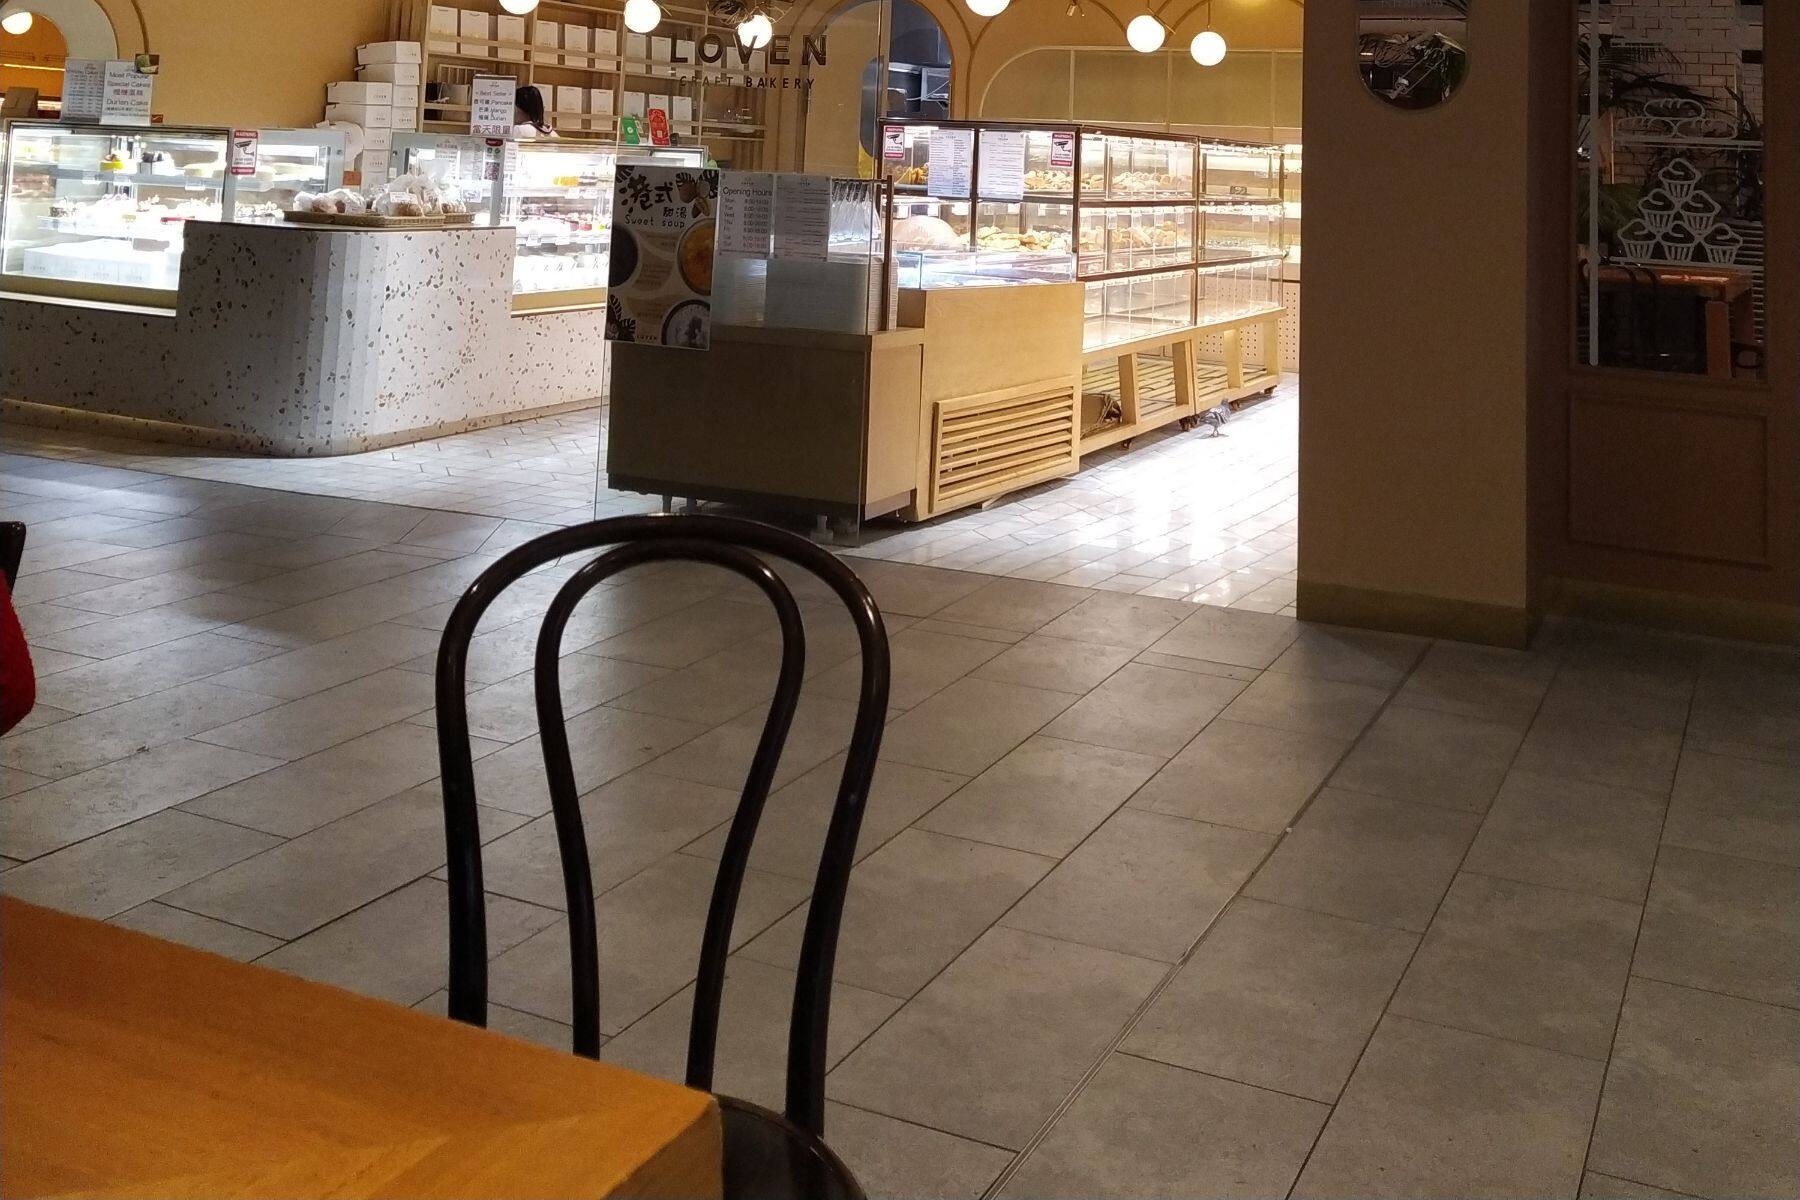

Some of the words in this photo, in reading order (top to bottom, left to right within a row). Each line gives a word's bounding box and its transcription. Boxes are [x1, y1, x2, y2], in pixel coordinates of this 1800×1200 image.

[679, 75, 734, 88] CRAFT
[745, 77, 816, 90] BAKERY
[722, 186, 751, 197] Opening
[752, 187, 773, 196] Hours
[662, 220, 685, 228] soup
